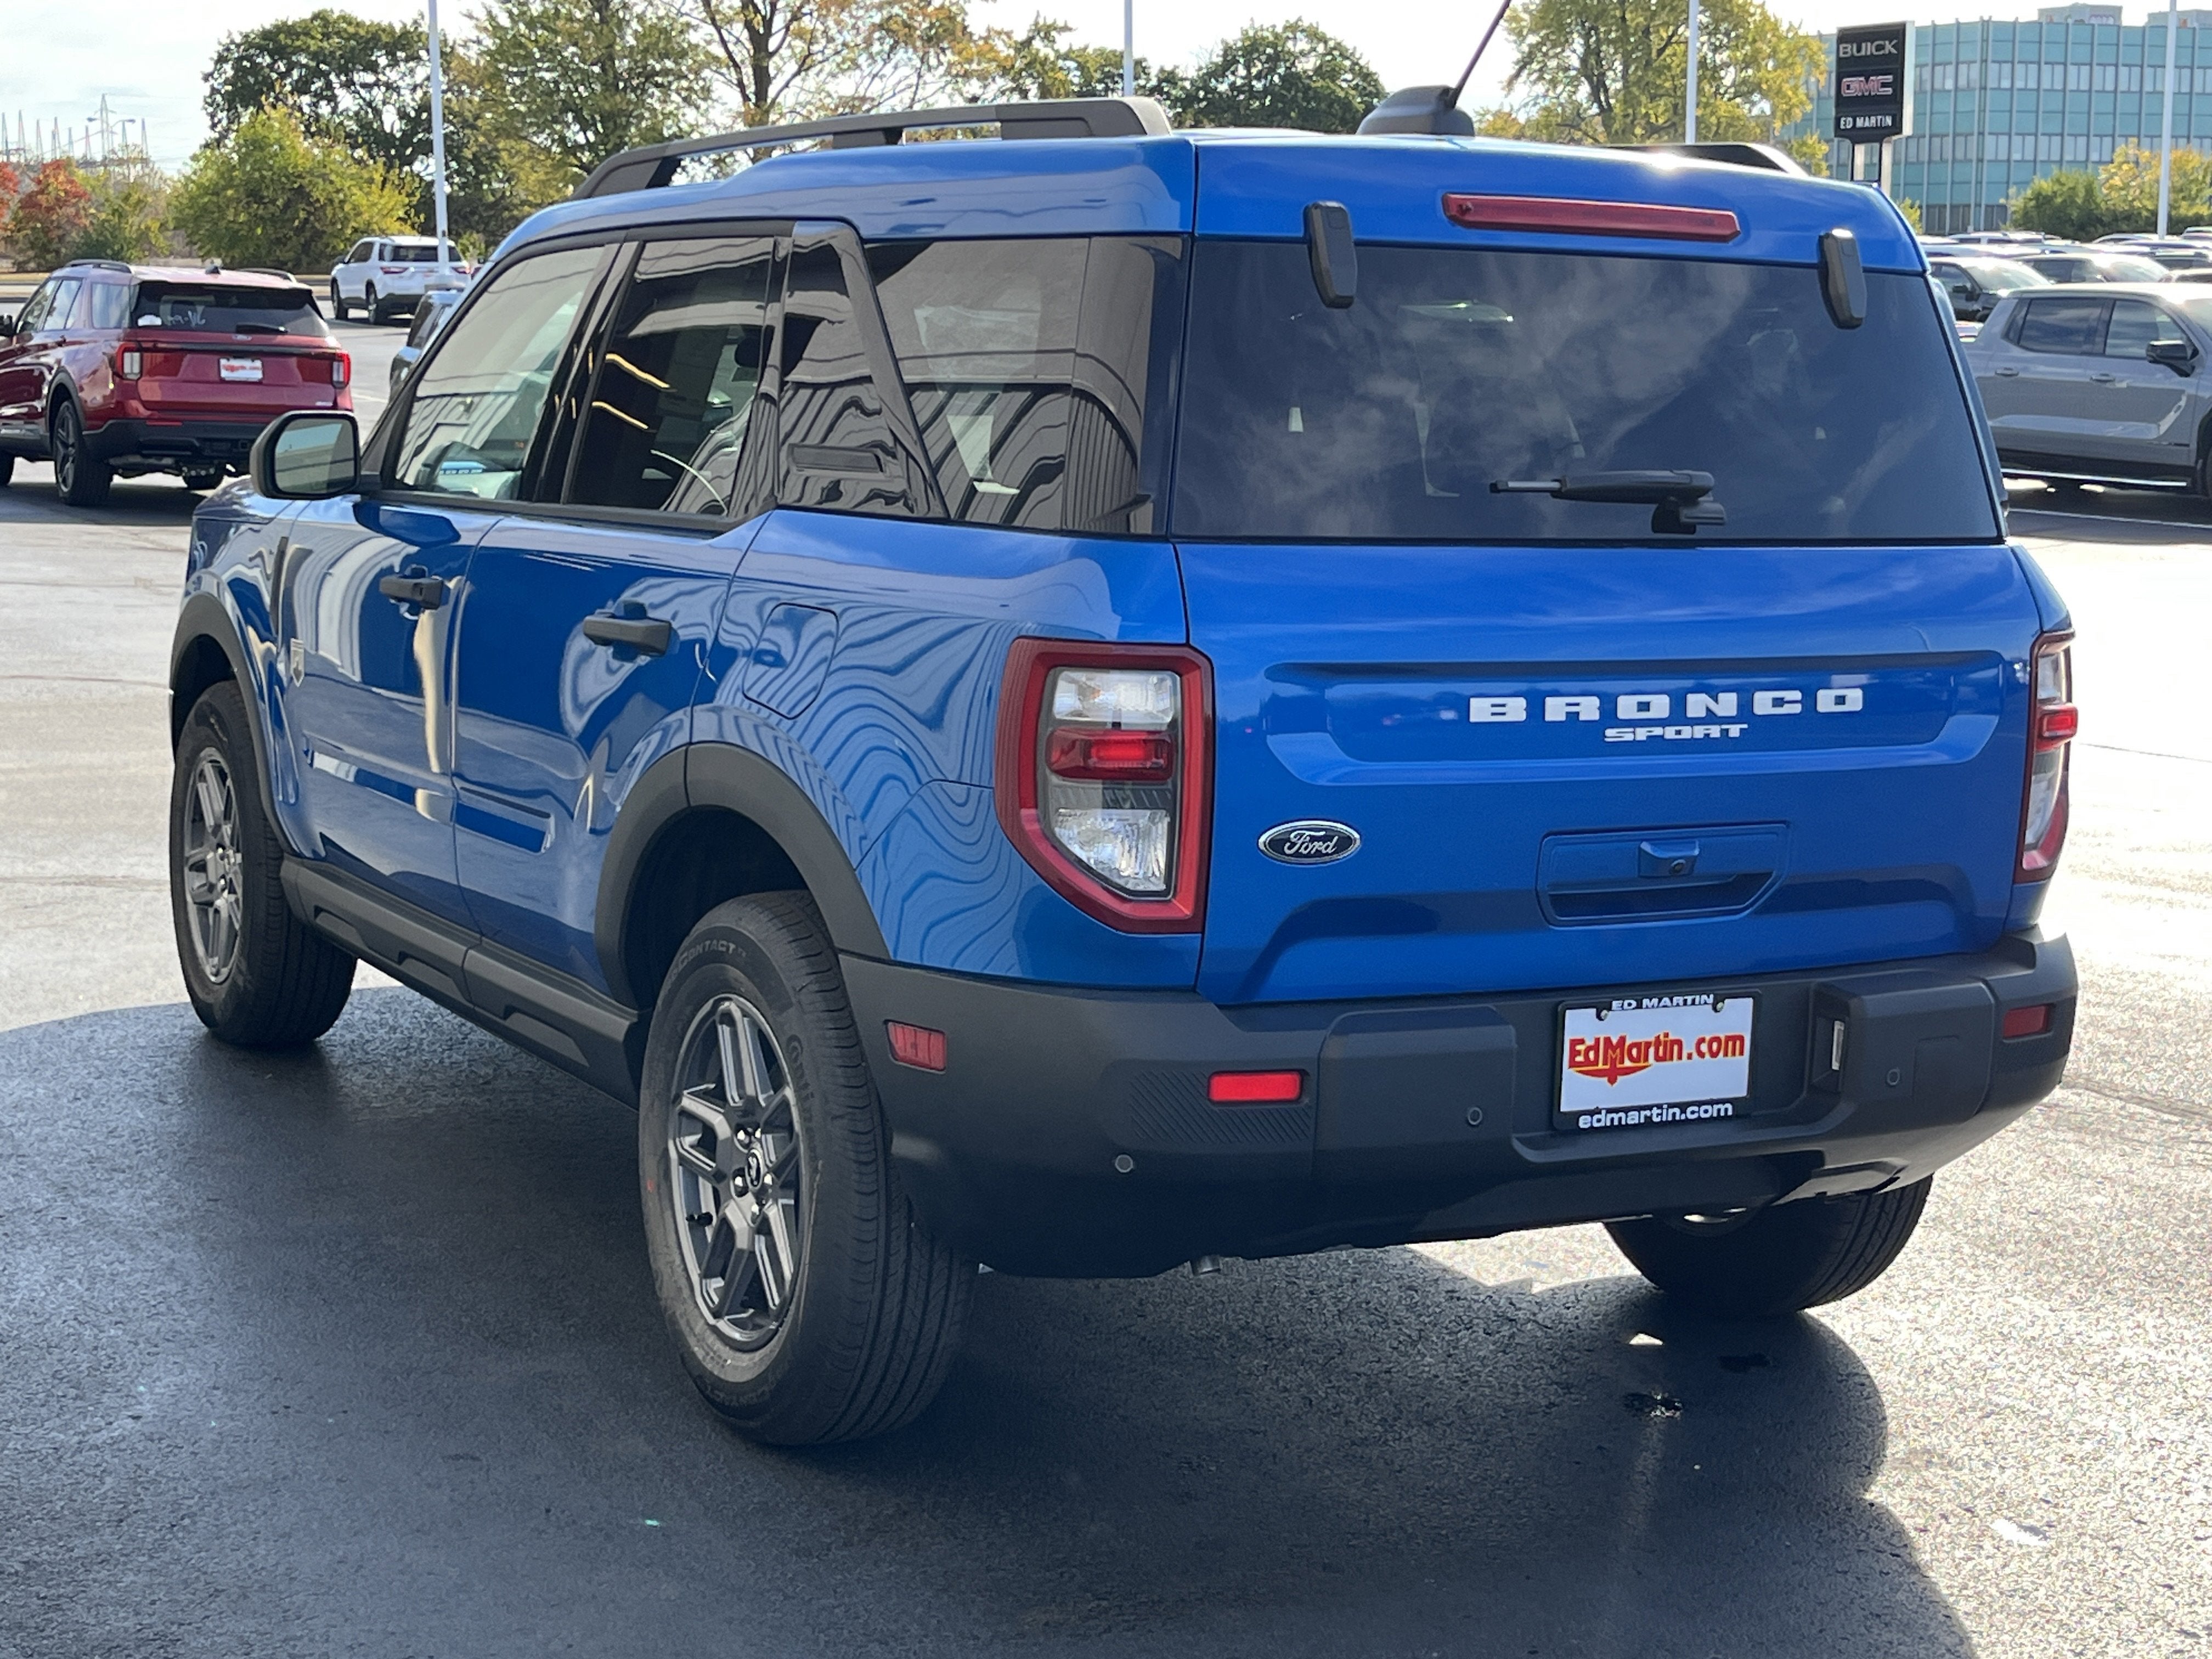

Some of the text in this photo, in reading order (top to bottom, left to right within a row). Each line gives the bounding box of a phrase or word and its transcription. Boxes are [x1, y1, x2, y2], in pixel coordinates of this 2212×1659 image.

[1839, 40, 1898, 58] BUICK
[1841, 75, 1893, 97] GMC
[1840, 115, 1892, 129] ED MARTIN
[1469, 688, 1864, 723] BRONCO
[1604, 723, 1748, 742] SPORT
[1284, 830, 1339, 854] Ford
[1611, 994, 1714, 1011] ED MARTIN
[1568, 1031, 1745, 1069] EdMartin.com
[1578, 1102, 1733, 1129] edmartin.com
